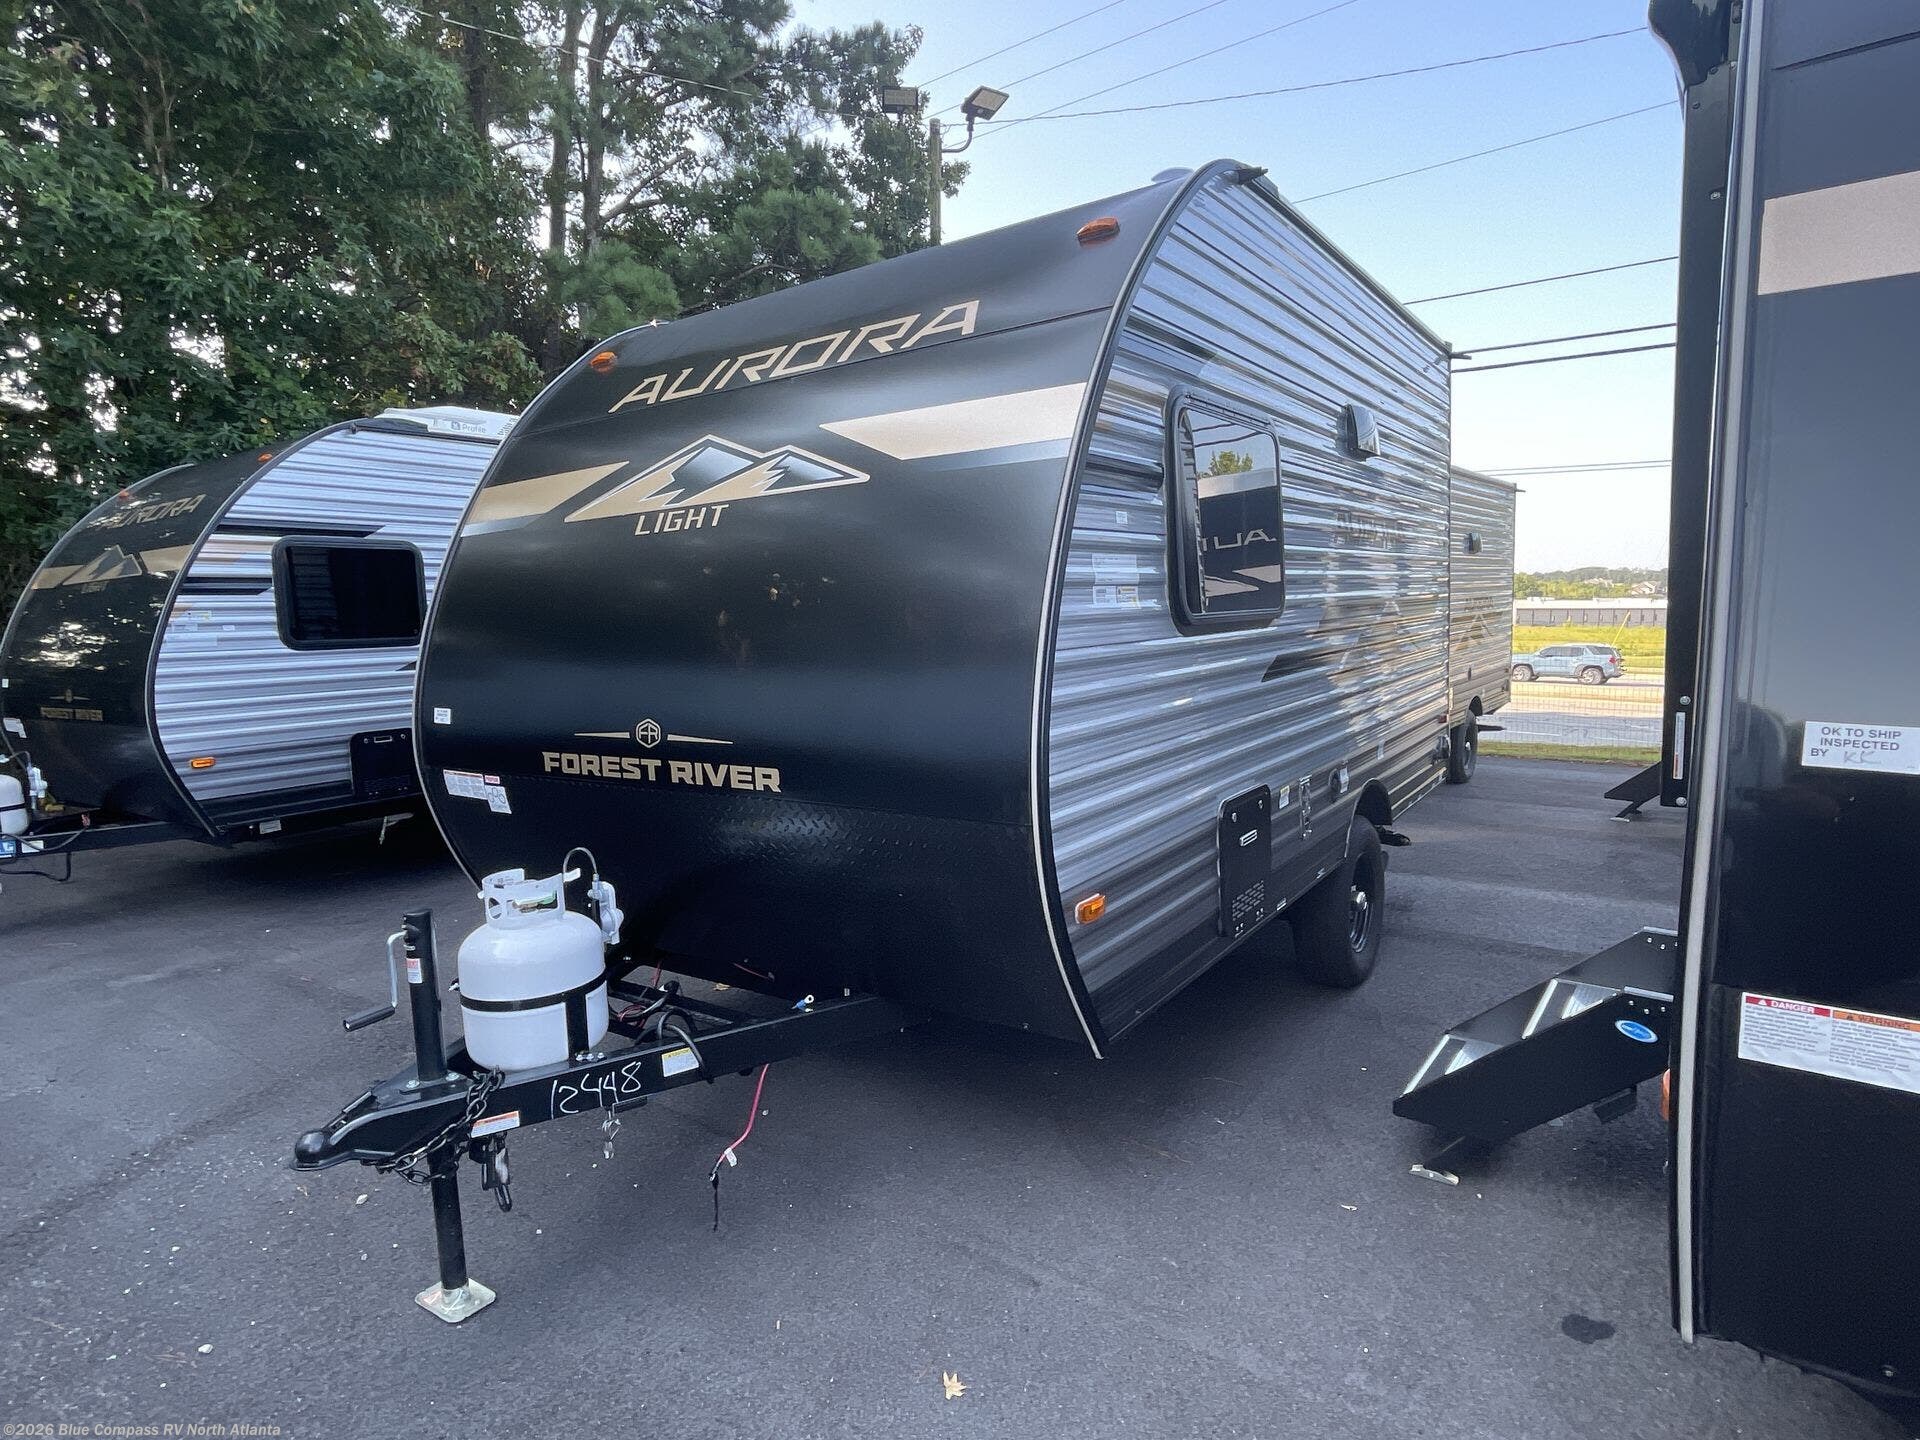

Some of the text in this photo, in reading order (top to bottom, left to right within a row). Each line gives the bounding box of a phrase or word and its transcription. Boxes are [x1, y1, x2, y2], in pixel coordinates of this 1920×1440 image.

[608, 300, 980, 414] AURORA
[635, 504, 730, 536] LIGHT
[1820, 737, 1900, 751] INSPECTED
[1821, 726, 1902, 740] OK TO SHIP
[1810, 747, 1830, 757] BY
[542, 751, 782, 793] FOREST RIVER
[1770, 1000, 1815, 1014] DANGER
[550, 1061, 642, 1120] 12448
